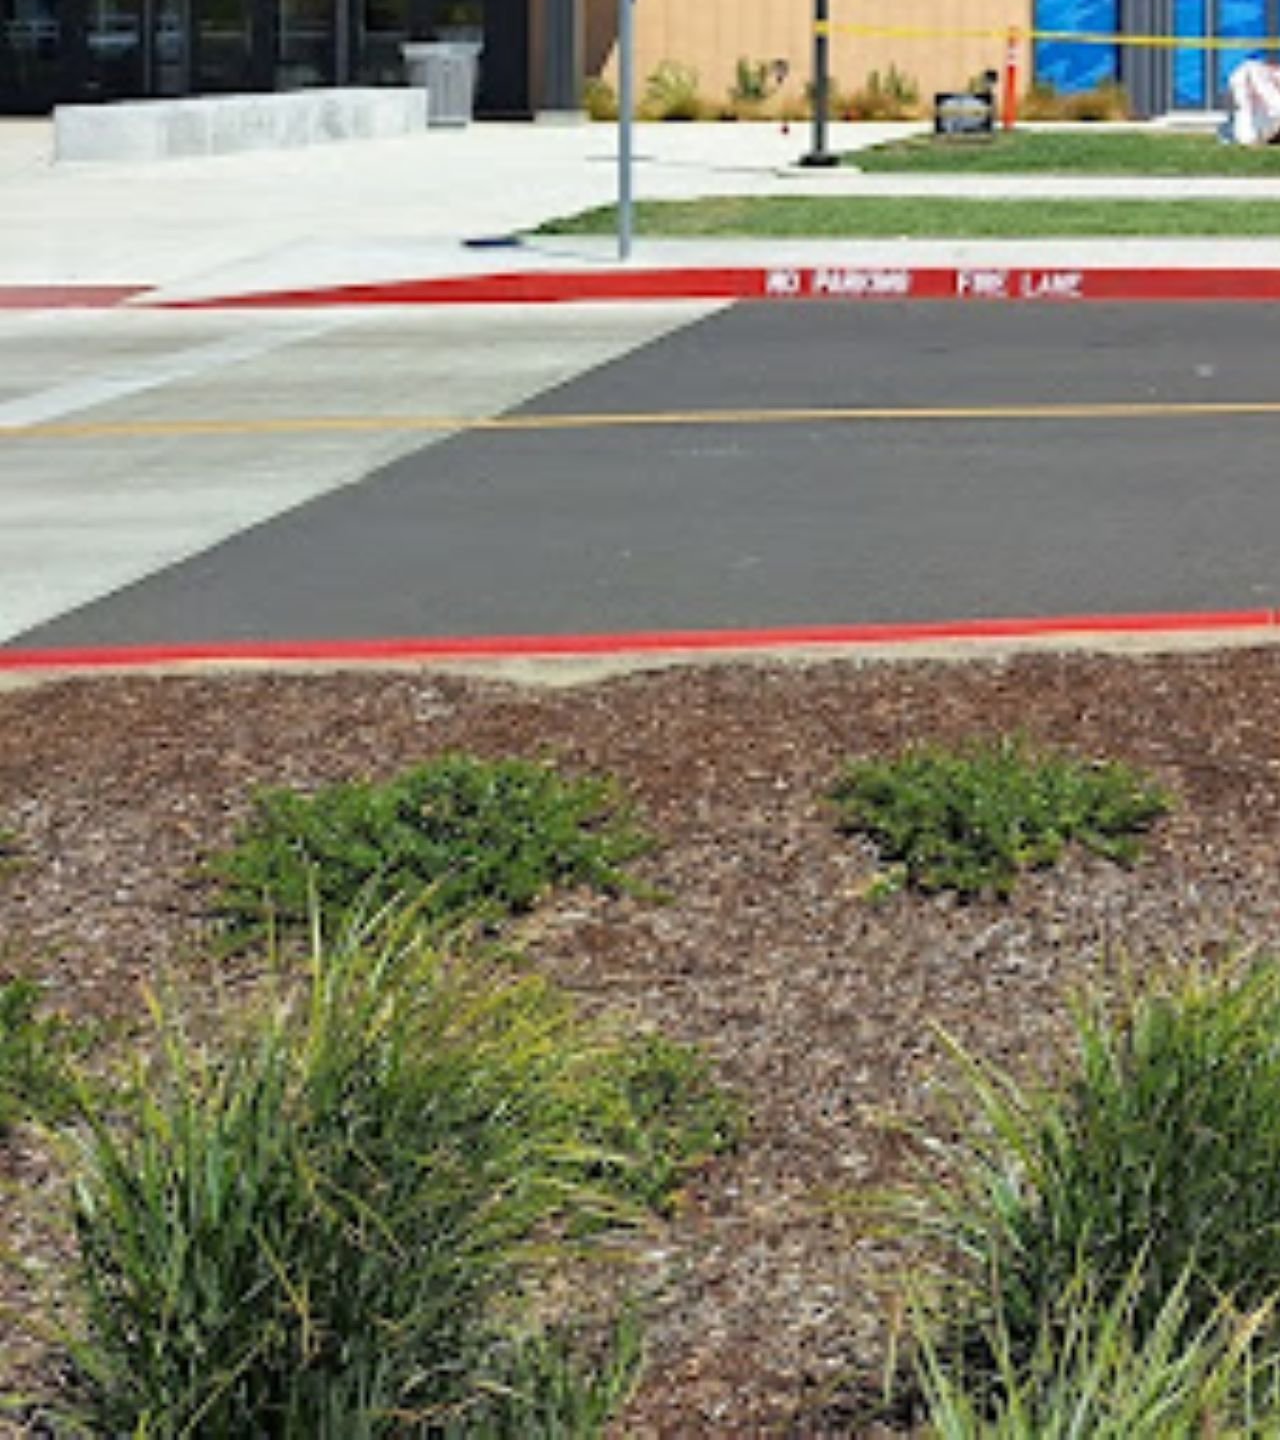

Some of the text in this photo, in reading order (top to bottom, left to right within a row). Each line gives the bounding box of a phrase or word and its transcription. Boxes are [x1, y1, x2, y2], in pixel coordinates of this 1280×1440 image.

[765, 270, 799, 296] NO
[957, 270, 1009, 297] FIRE
[1020, 270, 1084, 298] LANE
